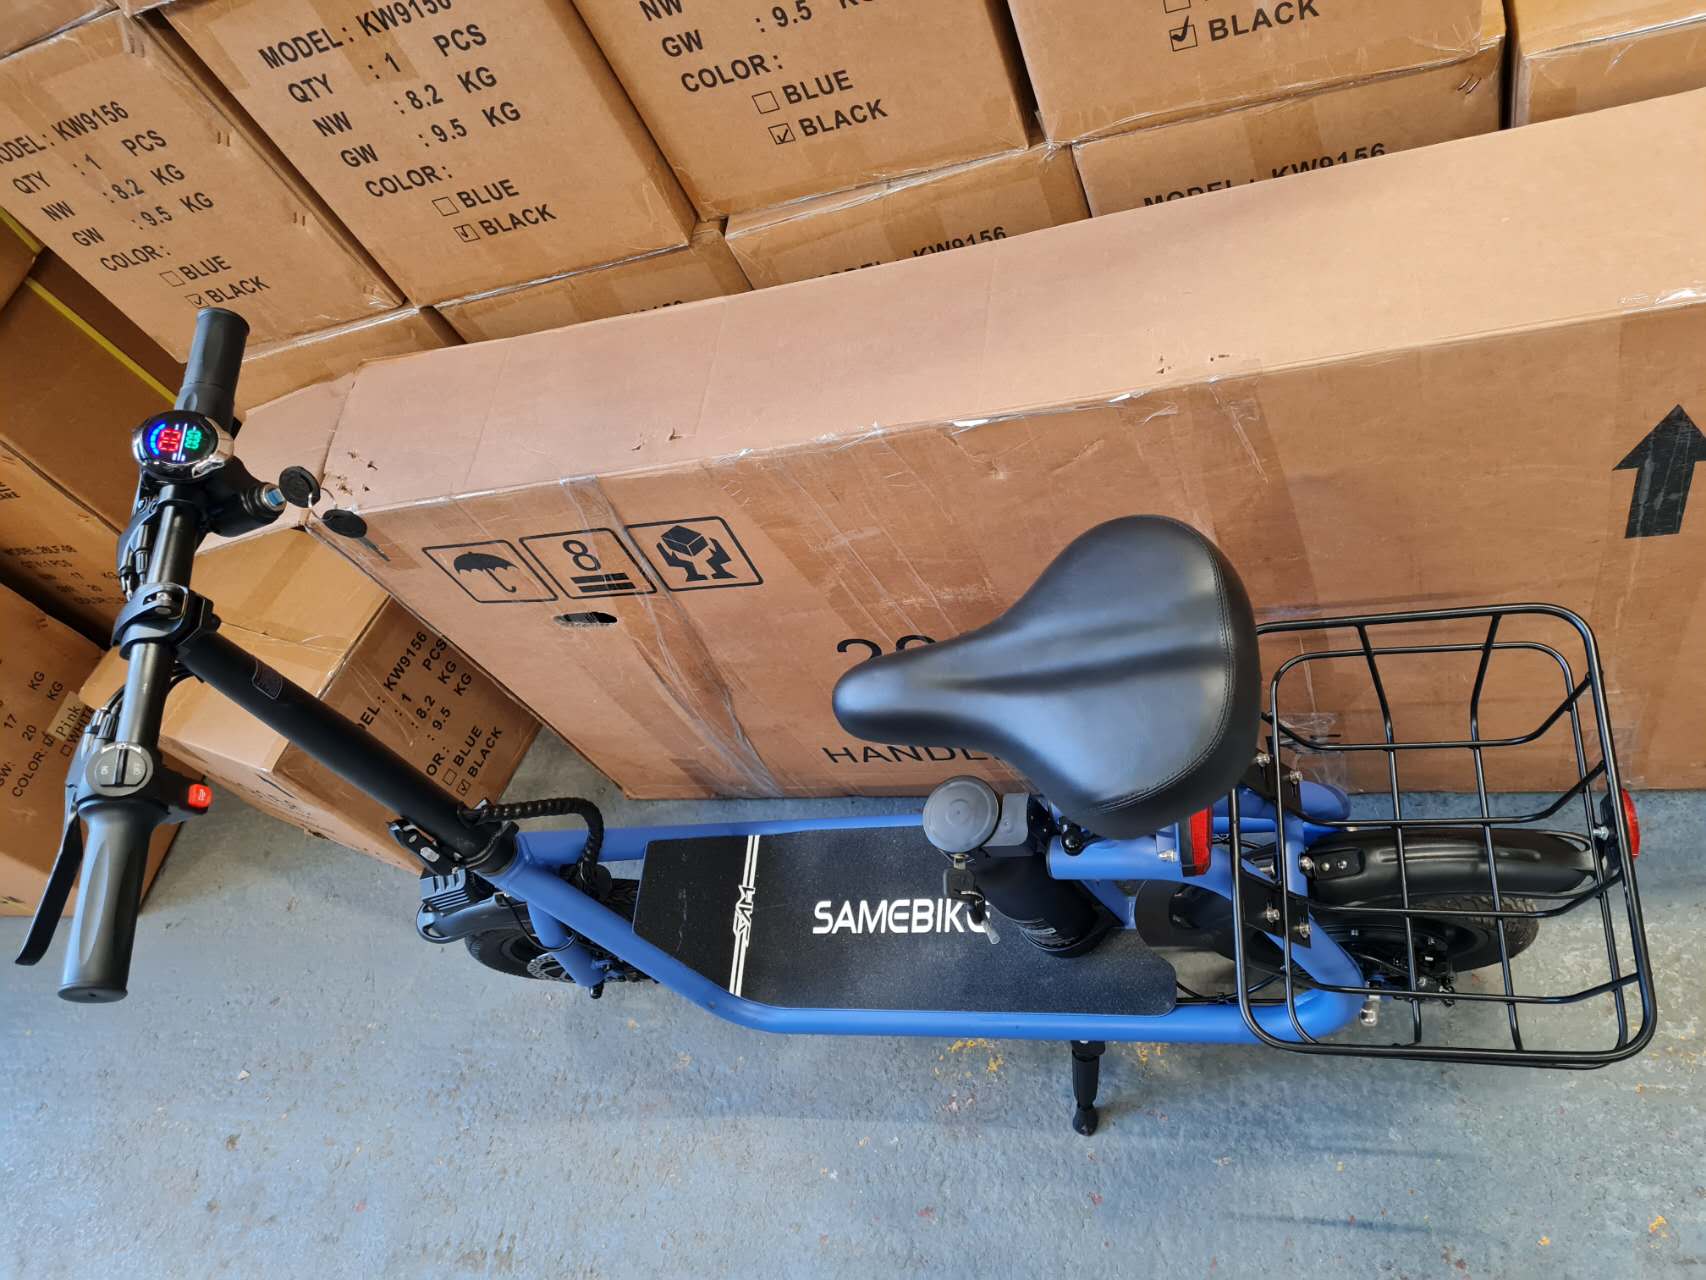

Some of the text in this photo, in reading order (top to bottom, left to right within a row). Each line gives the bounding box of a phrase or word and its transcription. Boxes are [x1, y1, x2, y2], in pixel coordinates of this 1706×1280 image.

[1208, 0, 1320, 41] BLACK
[258, 27, 354, 69] MODEL:
[287, 73, 334, 104] QTY
[433, 24, 487, 57] PCS
[661, 30, 703, 57] GW
[312, 111, 353, 138] NW
[457, 66, 498, 94] KG
[782, 70, 854, 105] BLUE
[0, 101, 129, 165] ODEL: KW9156
[340, 144, 379, 168] GW
[482, 102, 521, 128] KG
[799, 99, 888, 137] BLACK
[13, 171, 51, 194] QTY
[121, 130, 167, 157] PCS
[40, 200, 75, 222] NW
[151, 164, 185, 187] KG
[457, 179, 520, 209] BLUE
[72, 227, 105, 248] GW
[180, 192, 214, 214] KG
[479, 204, 557, 236] BLACK
[178, 255, 232, 282] BLUE
[205, 276, 270, 304] BLACK
[383, 631, 428, 692] KW9156
[422, 638, 448, 671] PCS
[437, 660, 457, 684] KG
[3, 671, 45, 729] 17 KG
[453, 672, 473, 697] KG
[22, 724, 37, 741] 20
[47, 681, 64, 701] KG
[55, 706, 82, 738] Pink
[453, 725, 482, 768] BLUE
[467, 726, 503, 778] BLACK
[821, 745, 1000, 763] HANDL
